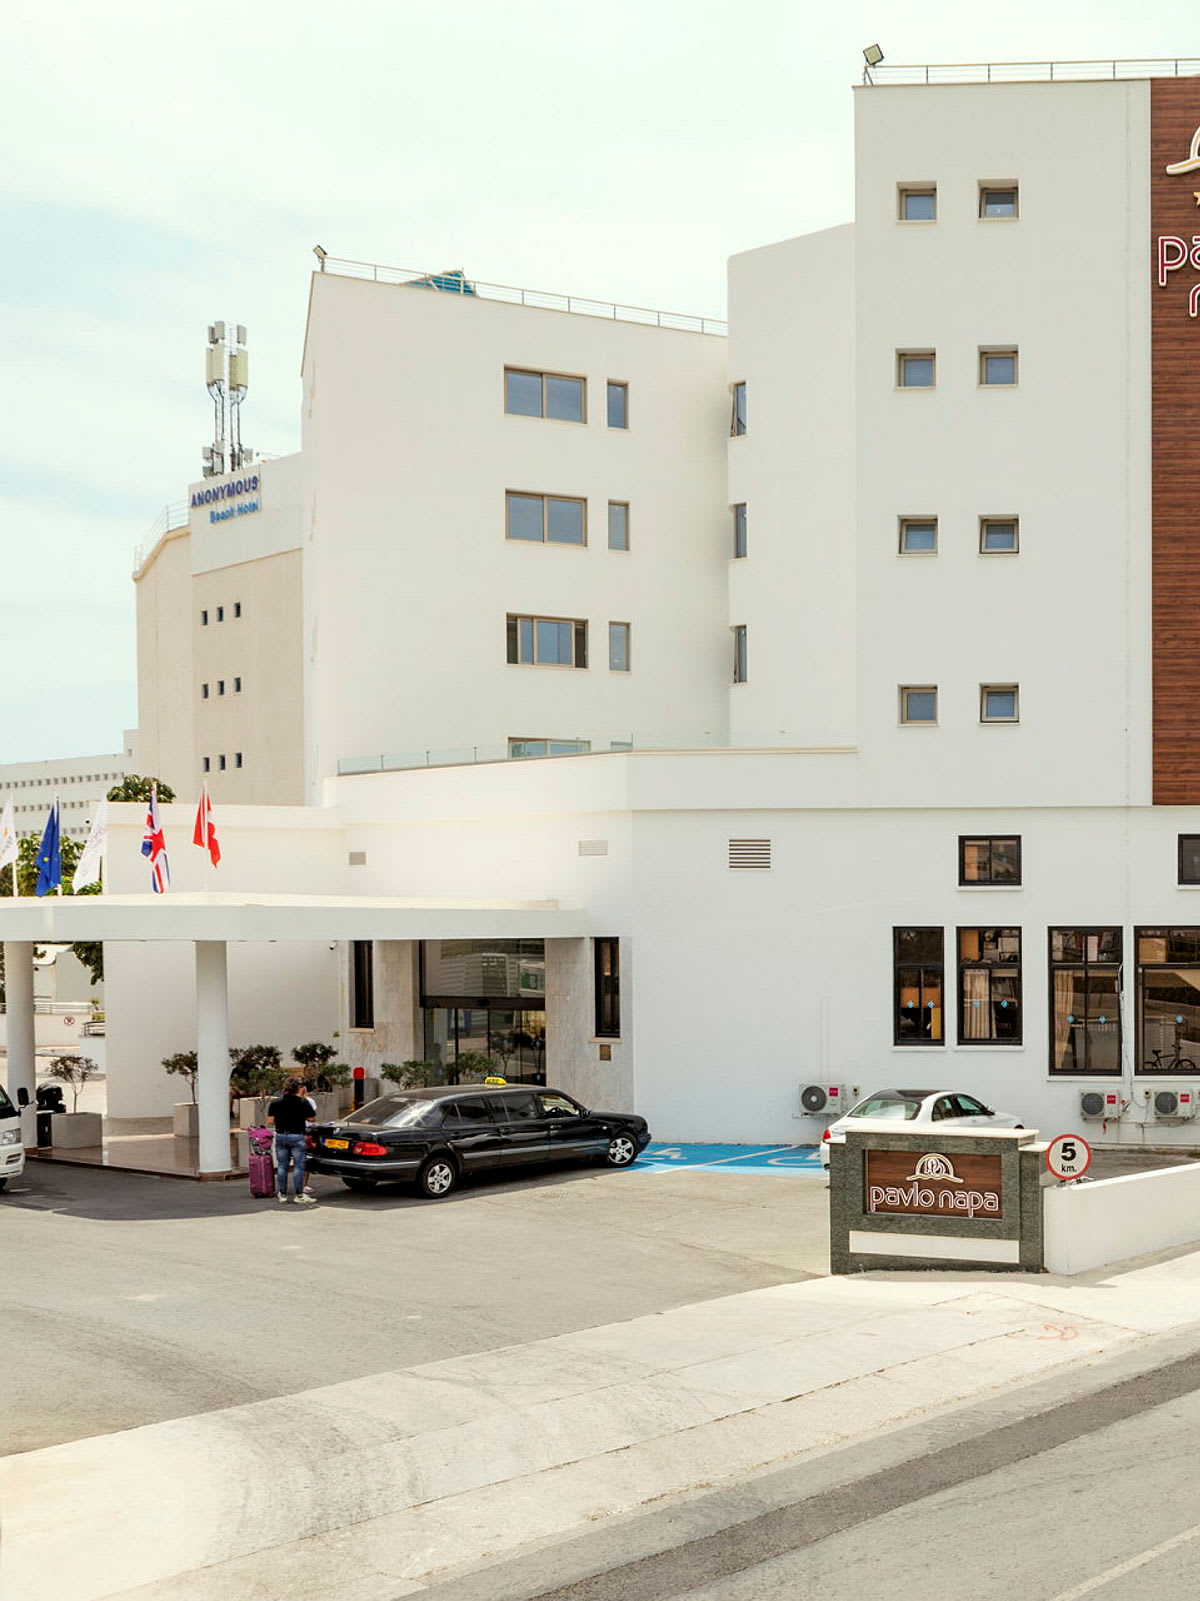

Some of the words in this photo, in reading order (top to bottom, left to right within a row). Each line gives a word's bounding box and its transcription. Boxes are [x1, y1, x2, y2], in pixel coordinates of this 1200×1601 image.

[191, 476, 259, 508] ANONYMOUS
[1061, 1142, 1077, 1161] 5
[869, 1181, 936, 1213] pavlo
[938, 1189, 999, 1219] napa
